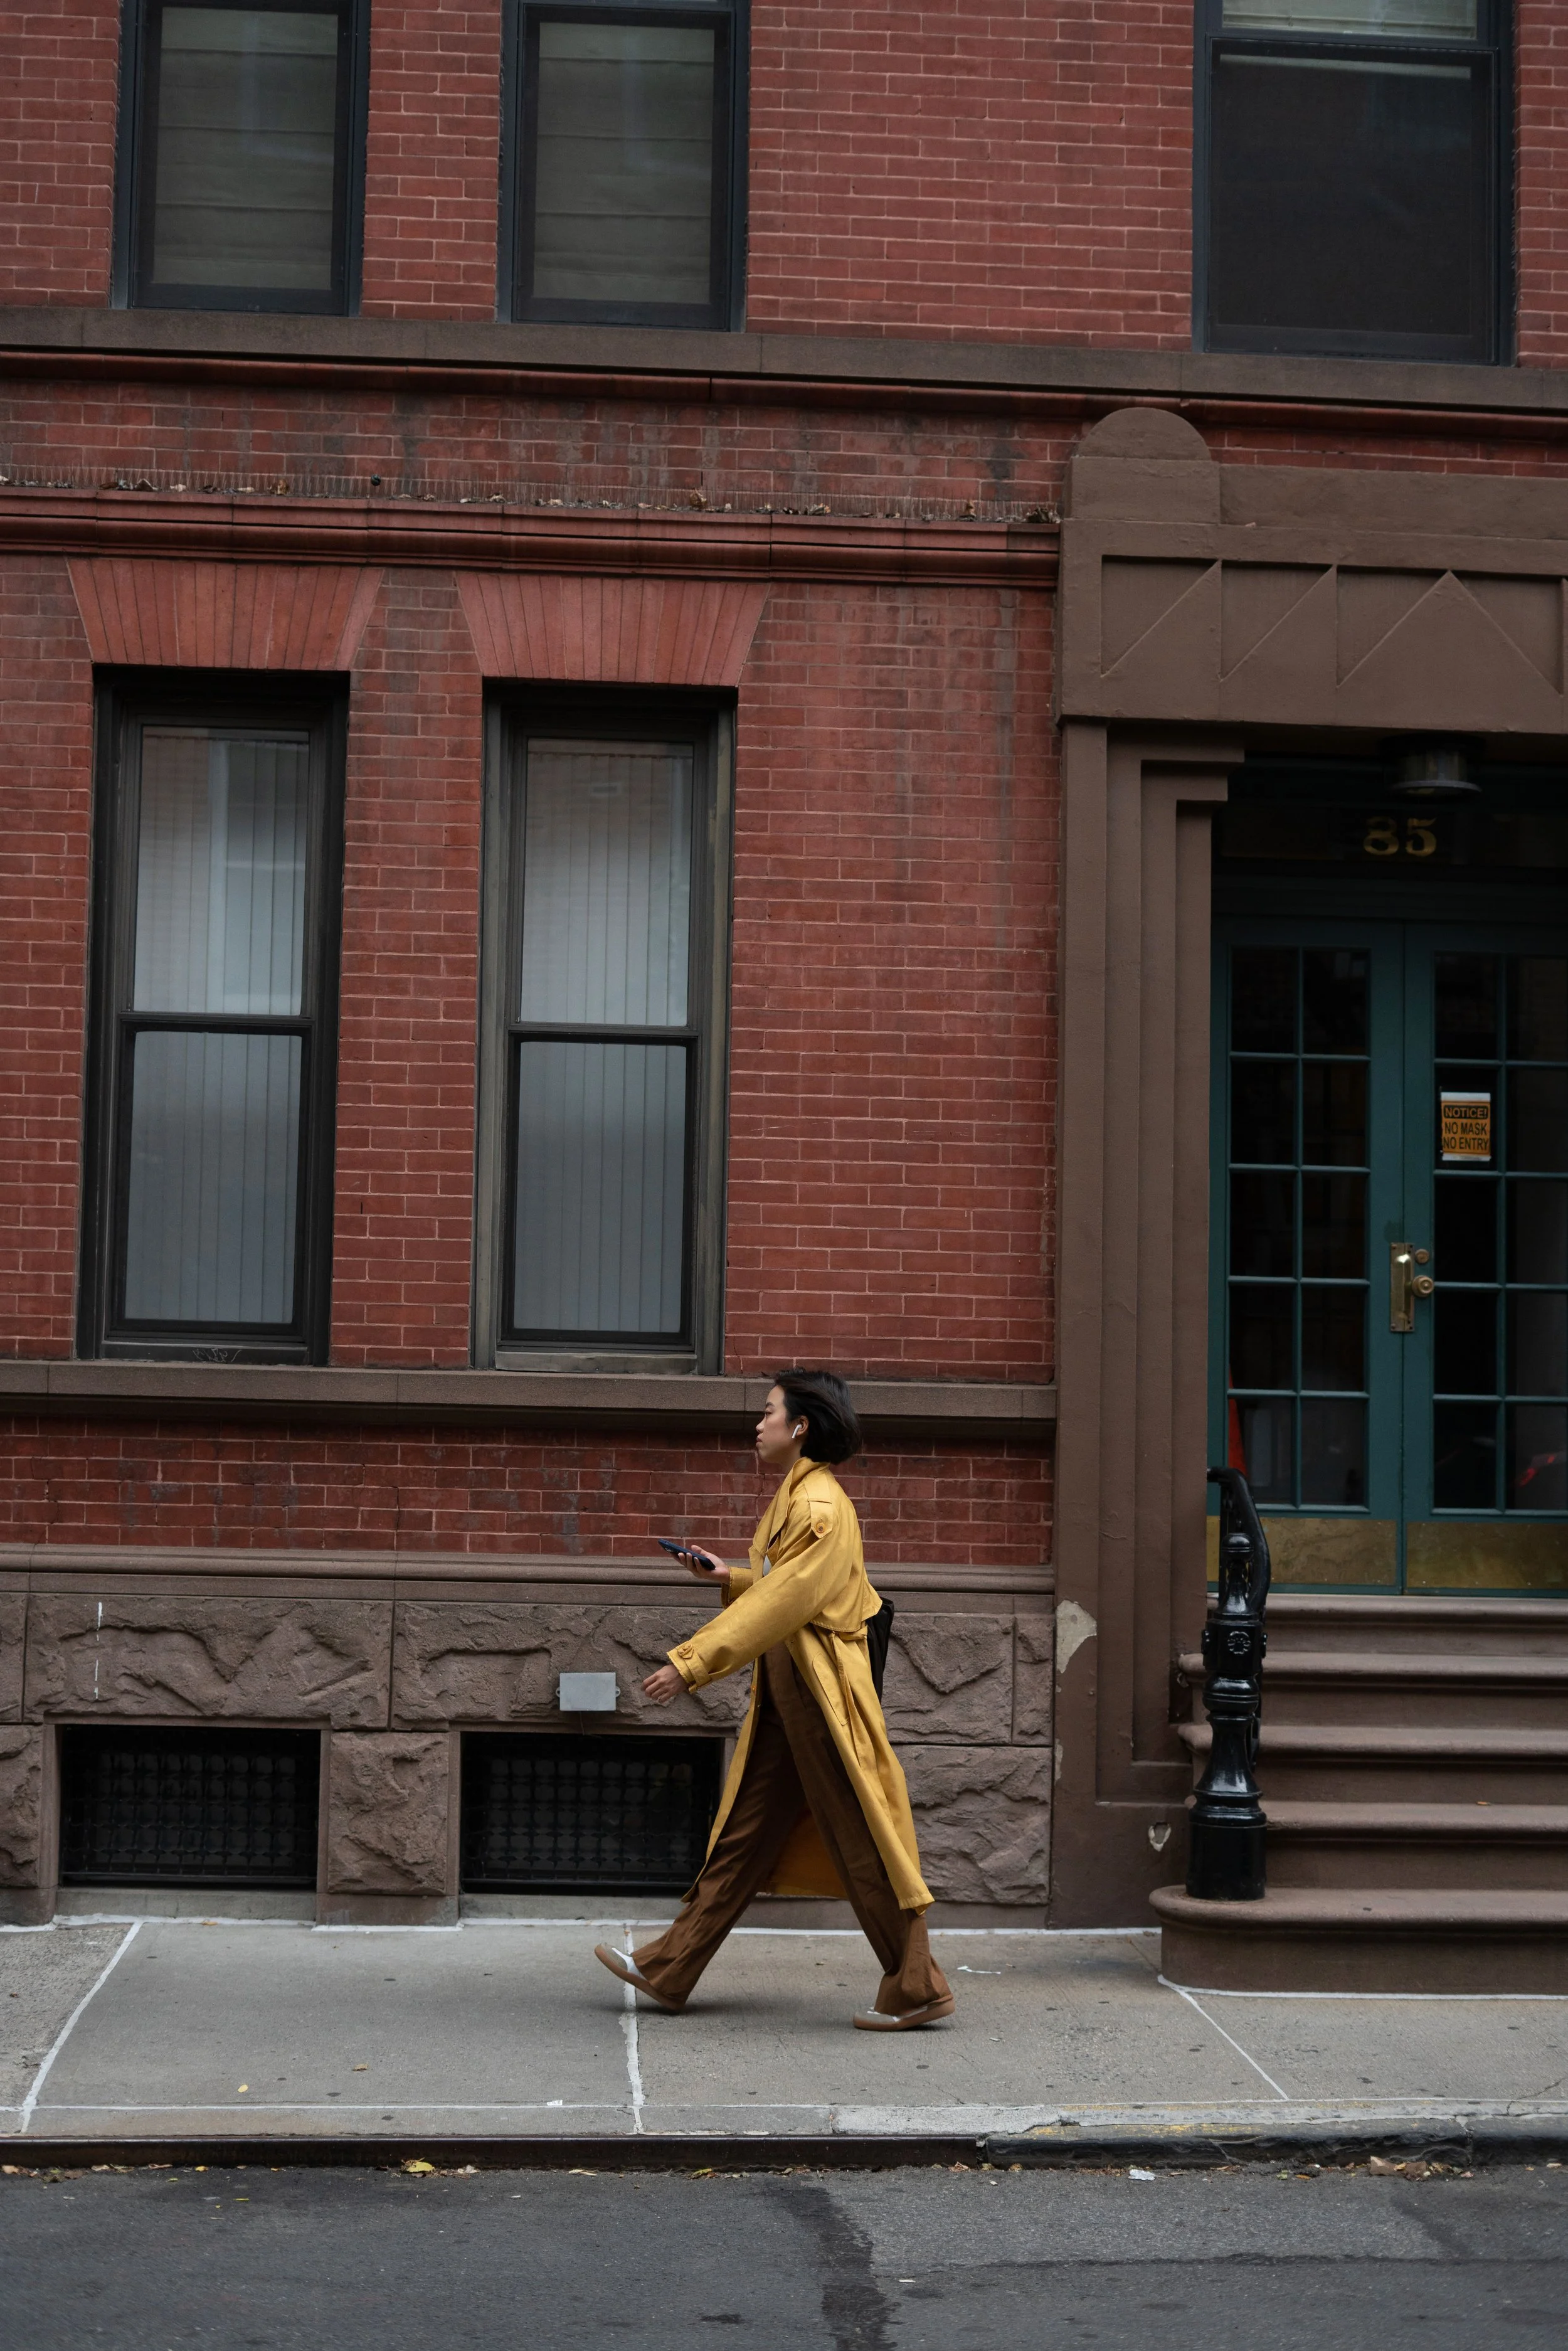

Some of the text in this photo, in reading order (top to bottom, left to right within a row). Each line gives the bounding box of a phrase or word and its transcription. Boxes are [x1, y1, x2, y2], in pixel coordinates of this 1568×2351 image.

[1363, 815, 1438, 857] 85
[1444, 1107, 1487, 1118] NOTICE!
[1444, 1122, 1487, 1135] NO MASK
[1443, 1137, 1489, 1150] NO ENTRY
